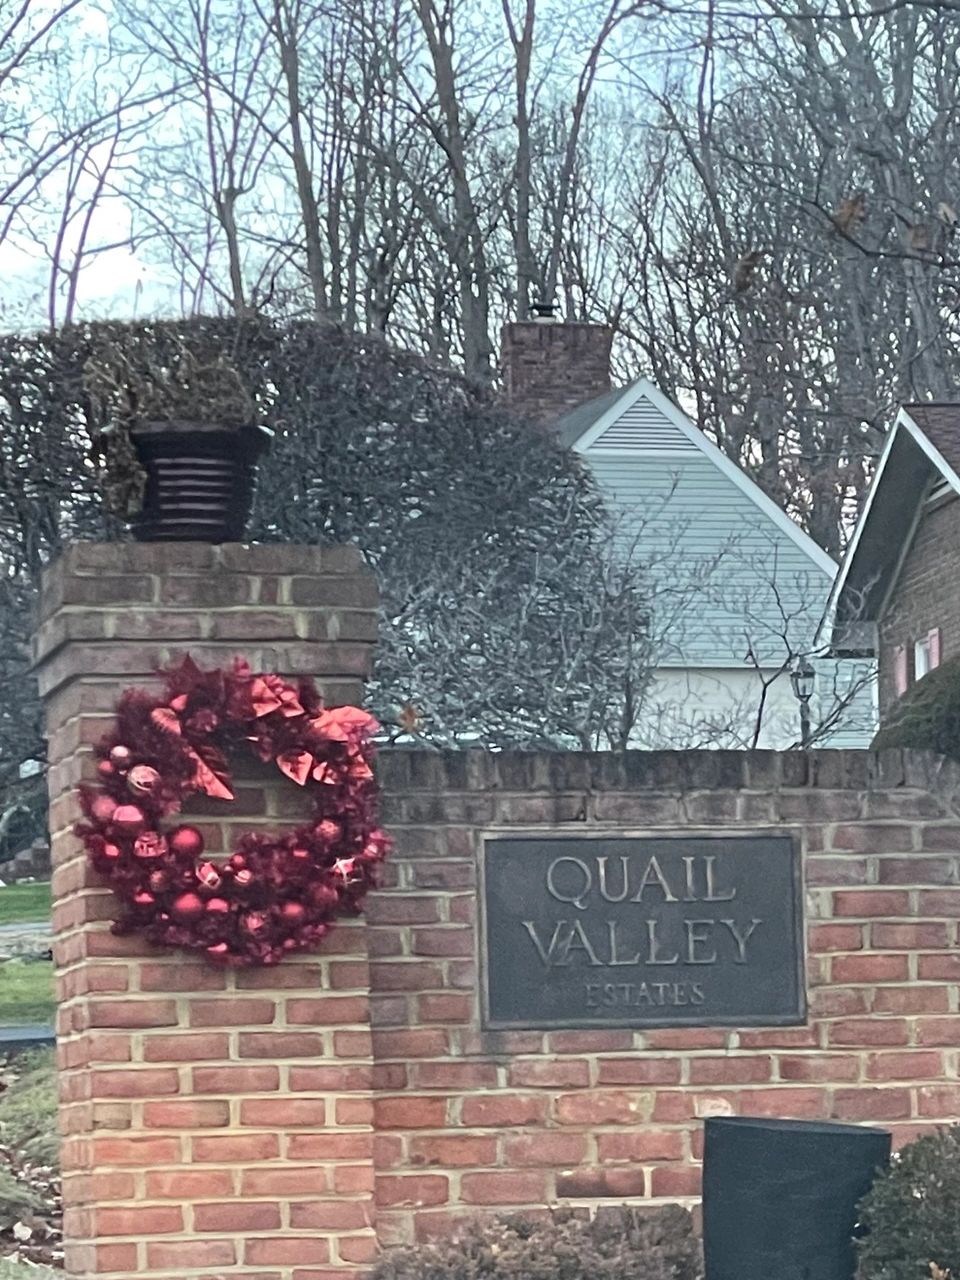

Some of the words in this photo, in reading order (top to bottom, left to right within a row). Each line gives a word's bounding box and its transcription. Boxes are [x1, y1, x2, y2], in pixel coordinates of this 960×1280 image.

[546, 855, 737, 910] QUAIL
[521, 918, 762, 967] VALLEY
[585, 981, 705, 1007] ESTATES
